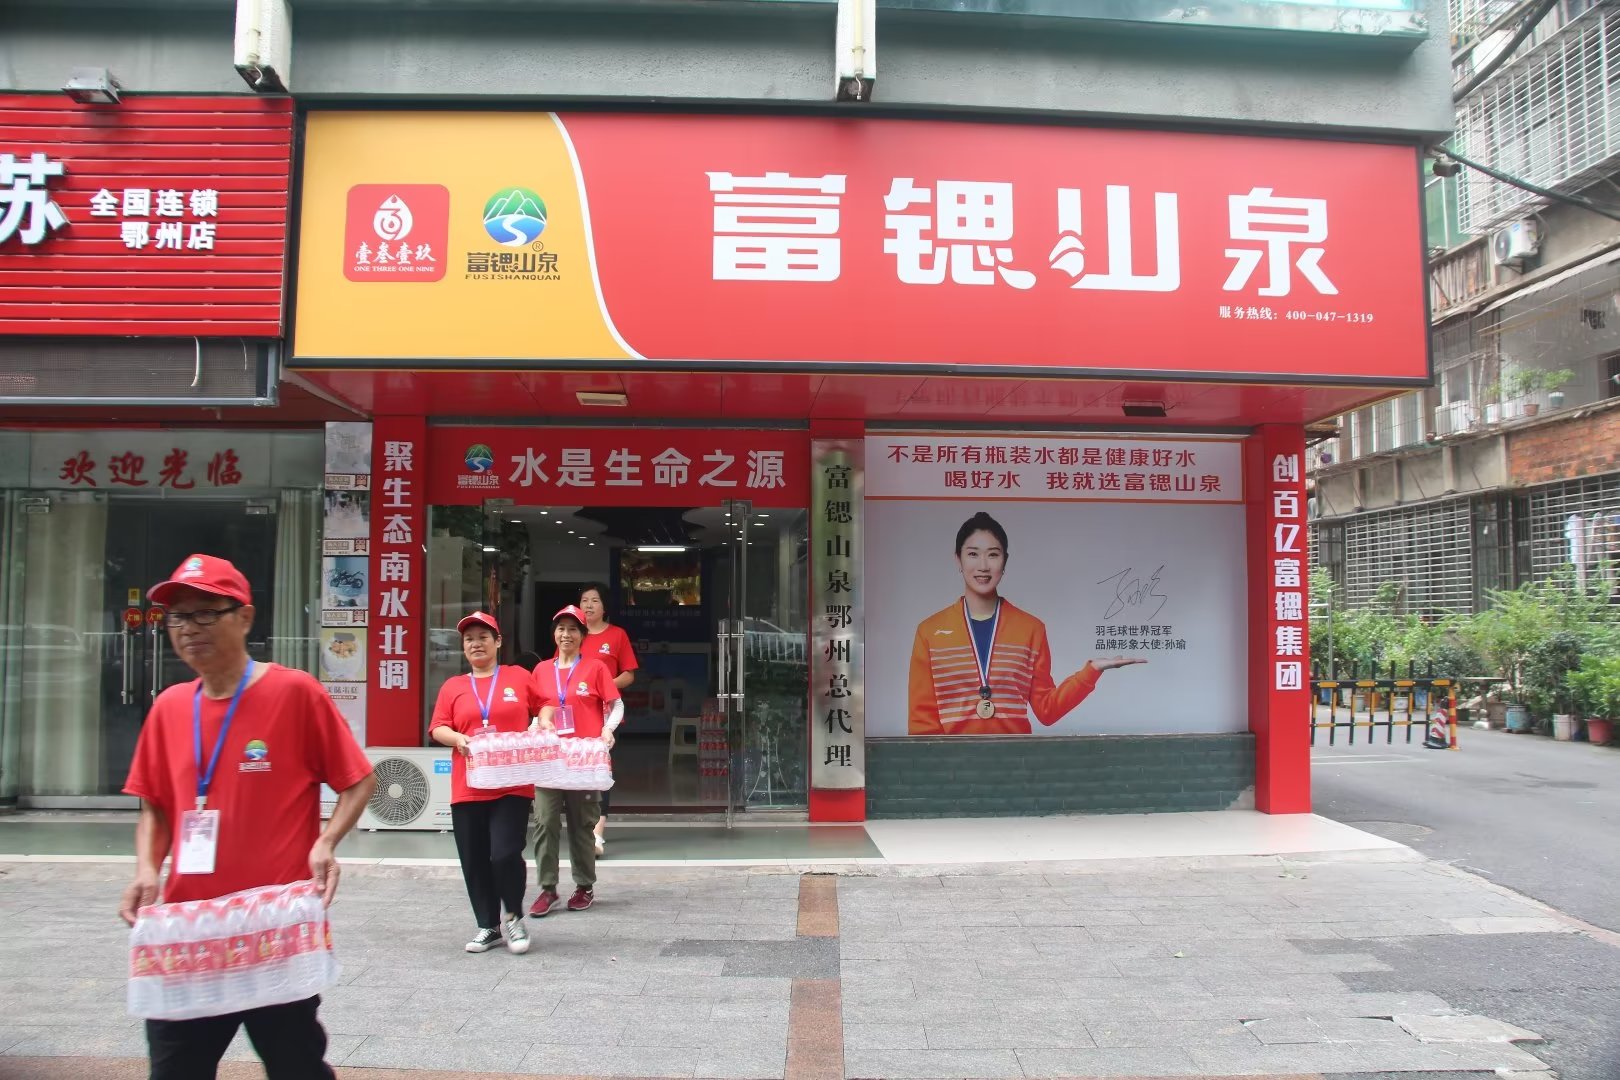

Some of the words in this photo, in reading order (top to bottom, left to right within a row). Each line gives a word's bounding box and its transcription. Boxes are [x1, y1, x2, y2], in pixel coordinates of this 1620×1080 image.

[0, 152, 72, 245] 苏
[89, 187, 219, 218] 全国连锁
[119, 220, 217, 251] 鄂州店
[704, 171, 1341, 298] 富锶山泉
[398, 265, 414, 273] ONE
[467, 251, 559, 273] 富锶山泉
[1285, 310, 1375, 323] 400-047-1319
[58, 447, 243, 490] 欢迎光临
[509, 447, 786, 490] 水是生命之源
[887, 444, 1197, 468] 不是所有瓶装水都是健康好水
[944, 470, 1022, 490] 喝好水
[1046, 471, 1223, 493] 我就选富锶山泉
[379, 440, 413, 690] 聚生态南水北调
[1272, 453, 1303, 691] 创百亿富锶集团
[824, 464, 854, 768] 富锶山泉鄂州总代理
[1095, 625, 1173, 637] 羽毛球世界冠军
[1095, 638, 1187, 651] 品牌形象大使:孙瑜
